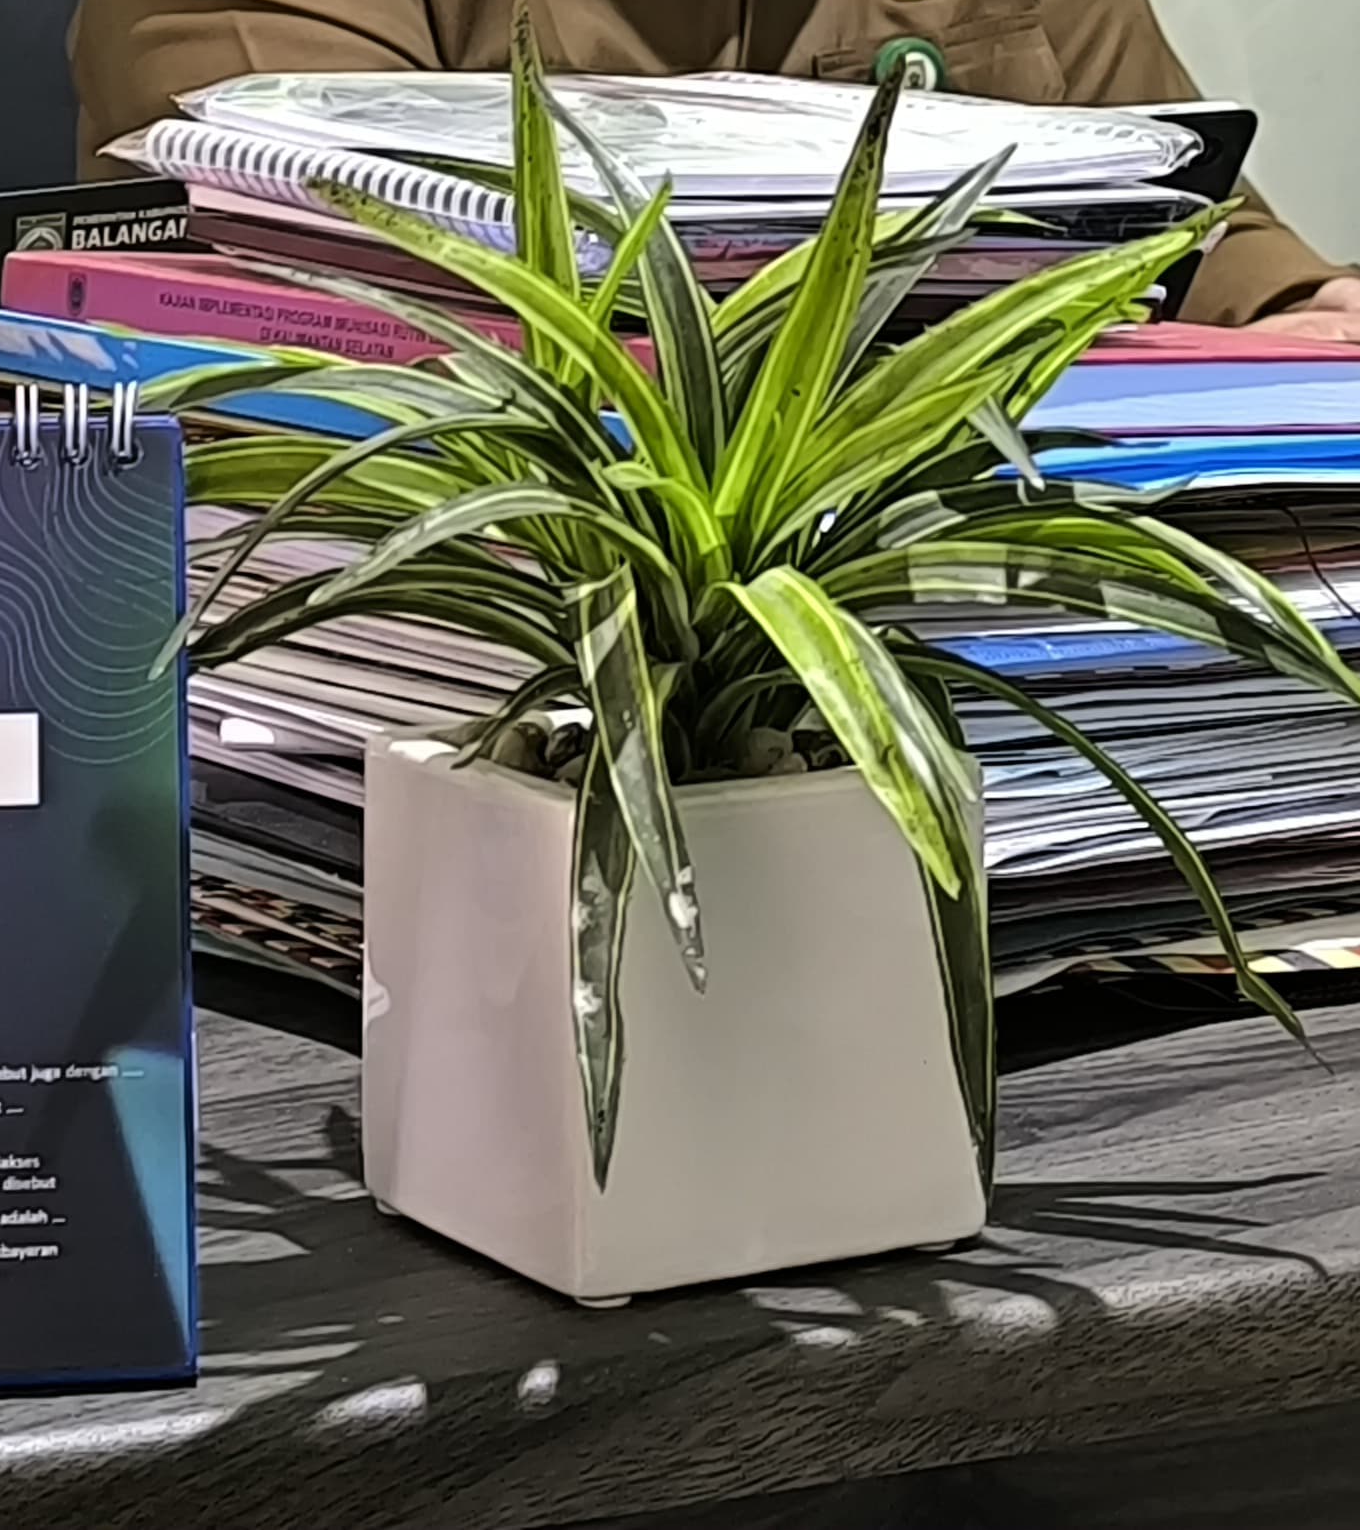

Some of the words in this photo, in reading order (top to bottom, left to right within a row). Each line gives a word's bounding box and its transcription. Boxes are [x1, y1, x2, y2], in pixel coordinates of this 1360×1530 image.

[30, 1065, 60, 1083] juga
[65, 1064, 118, 1080] dengan
[2, 1176, 56, 1191] disebut
[0, 1210, 48, 1225] adalah
